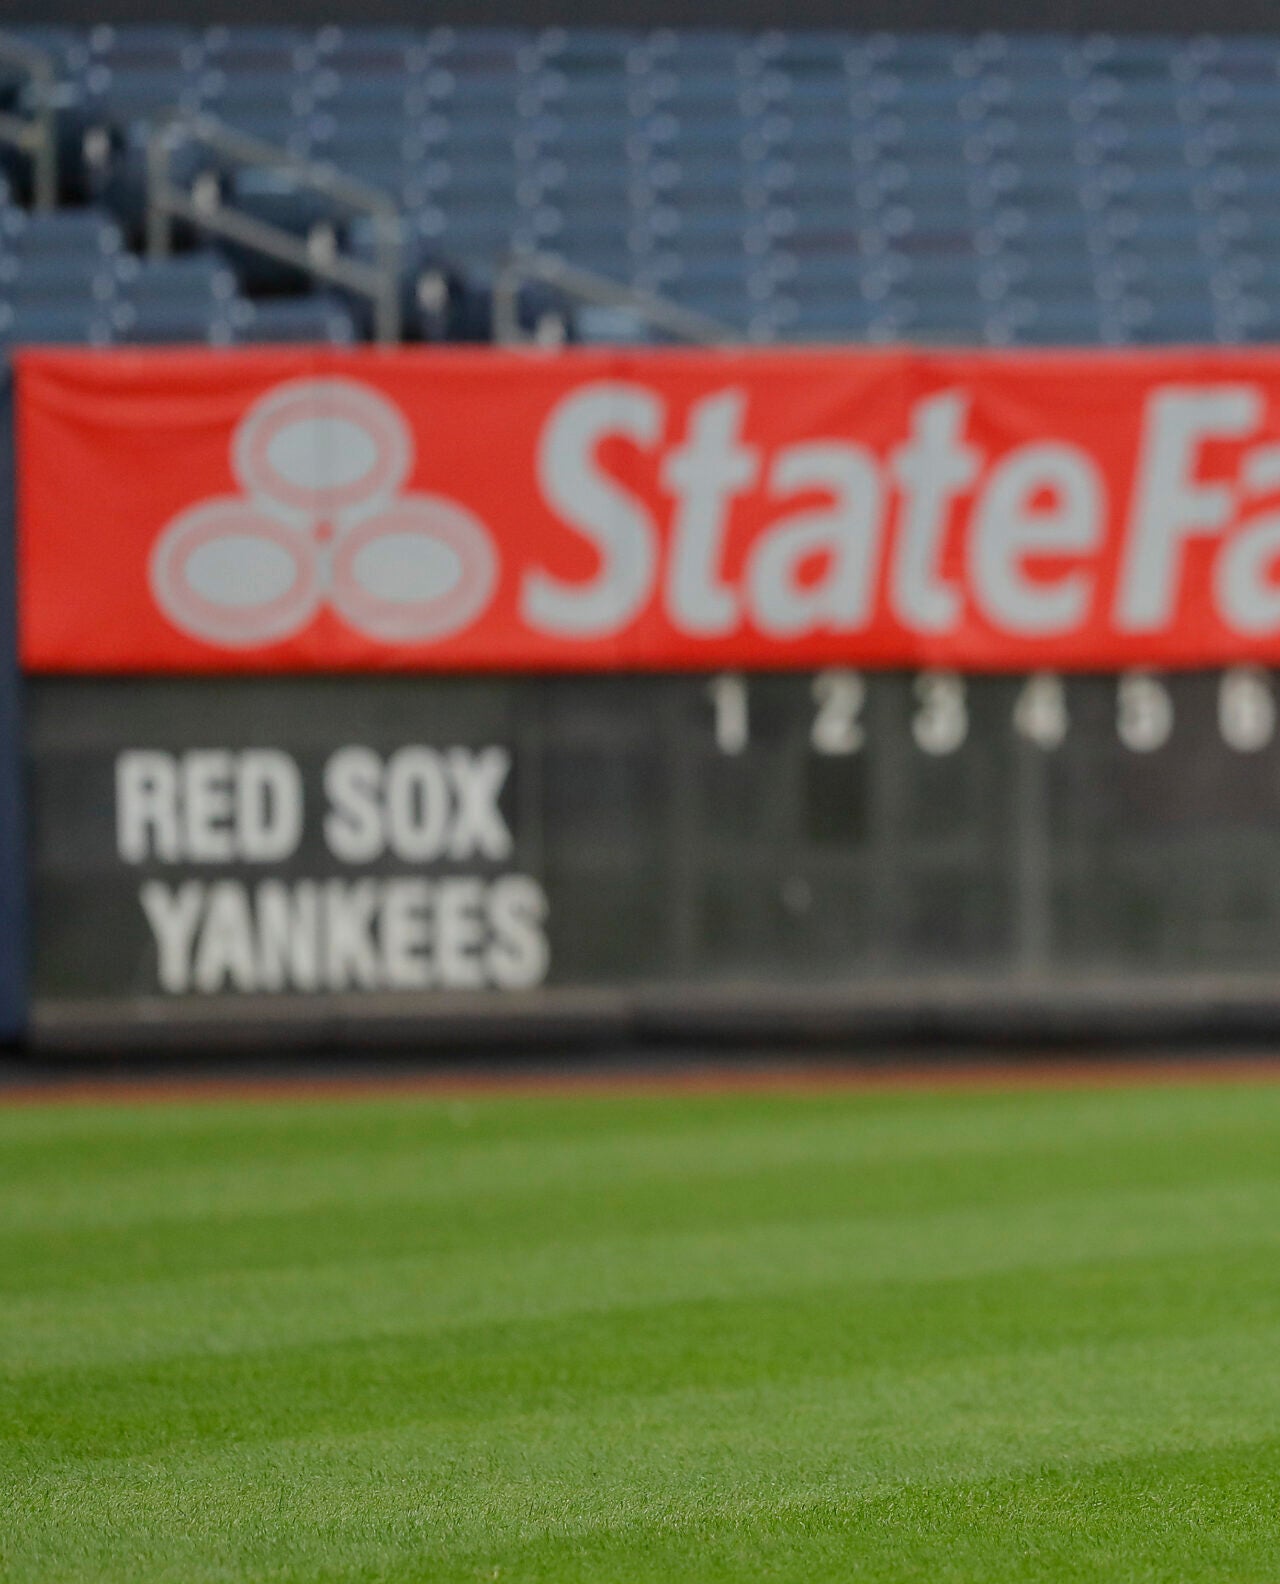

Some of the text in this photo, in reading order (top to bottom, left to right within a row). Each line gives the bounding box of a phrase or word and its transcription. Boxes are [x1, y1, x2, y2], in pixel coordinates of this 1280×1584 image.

[714, 675, 749, 756] 1
[809, 670, 865, 755] 2
[912, 672, 968, 755] 3
[115, 745, 512, 864] RED SOX
[141, 874, 549, 993] YANKEES
